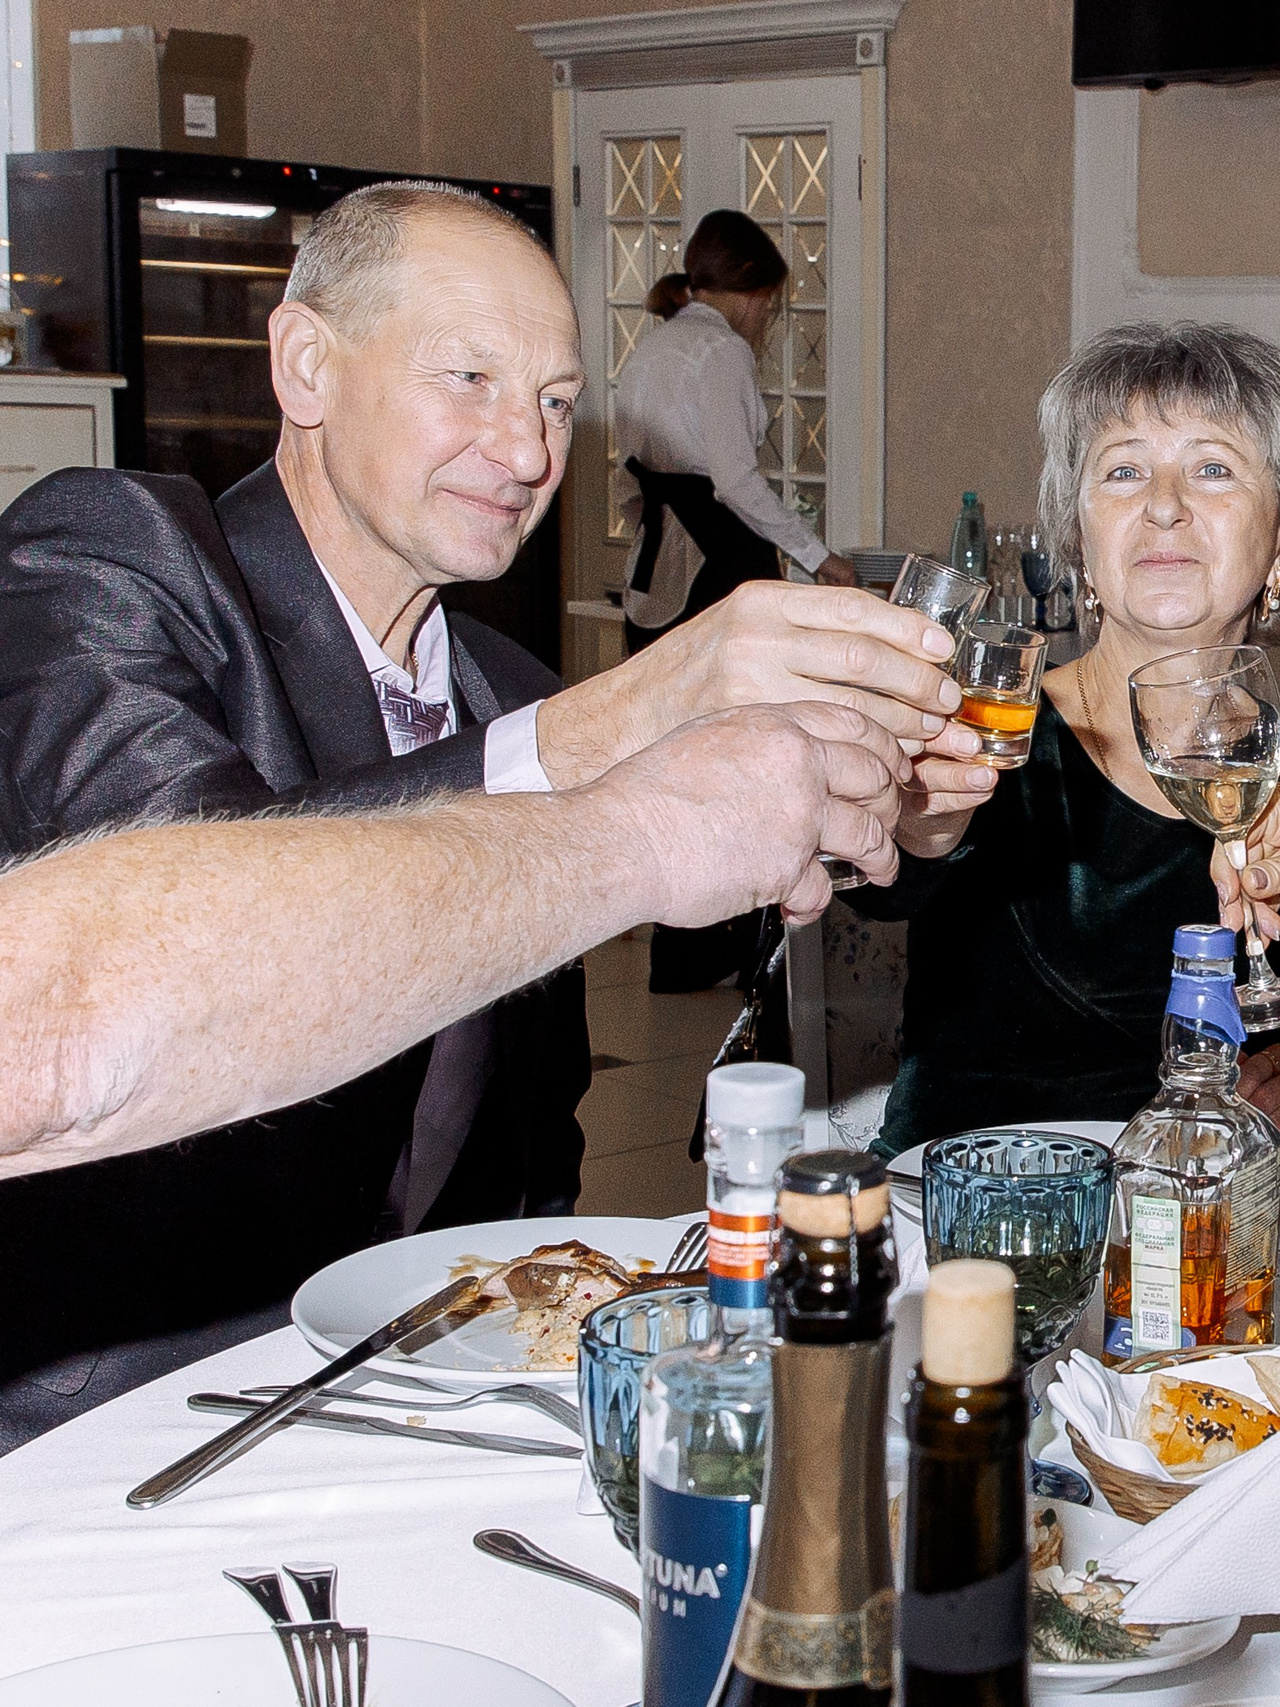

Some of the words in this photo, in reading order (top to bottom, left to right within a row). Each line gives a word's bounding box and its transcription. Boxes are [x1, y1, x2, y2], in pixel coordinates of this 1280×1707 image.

[1136, 1204, 1174, 1213] РОССИЙСКАЯ
[1136, 1209, 1174, 1218] ФЕДЕРАЦИЯ
[1134, 1232, 1175, 1241] ФЕДЕРАЛЬНАЯ
[1134, 1237, 1175, 1246] СПЕЦИАЛЬНАЯ
